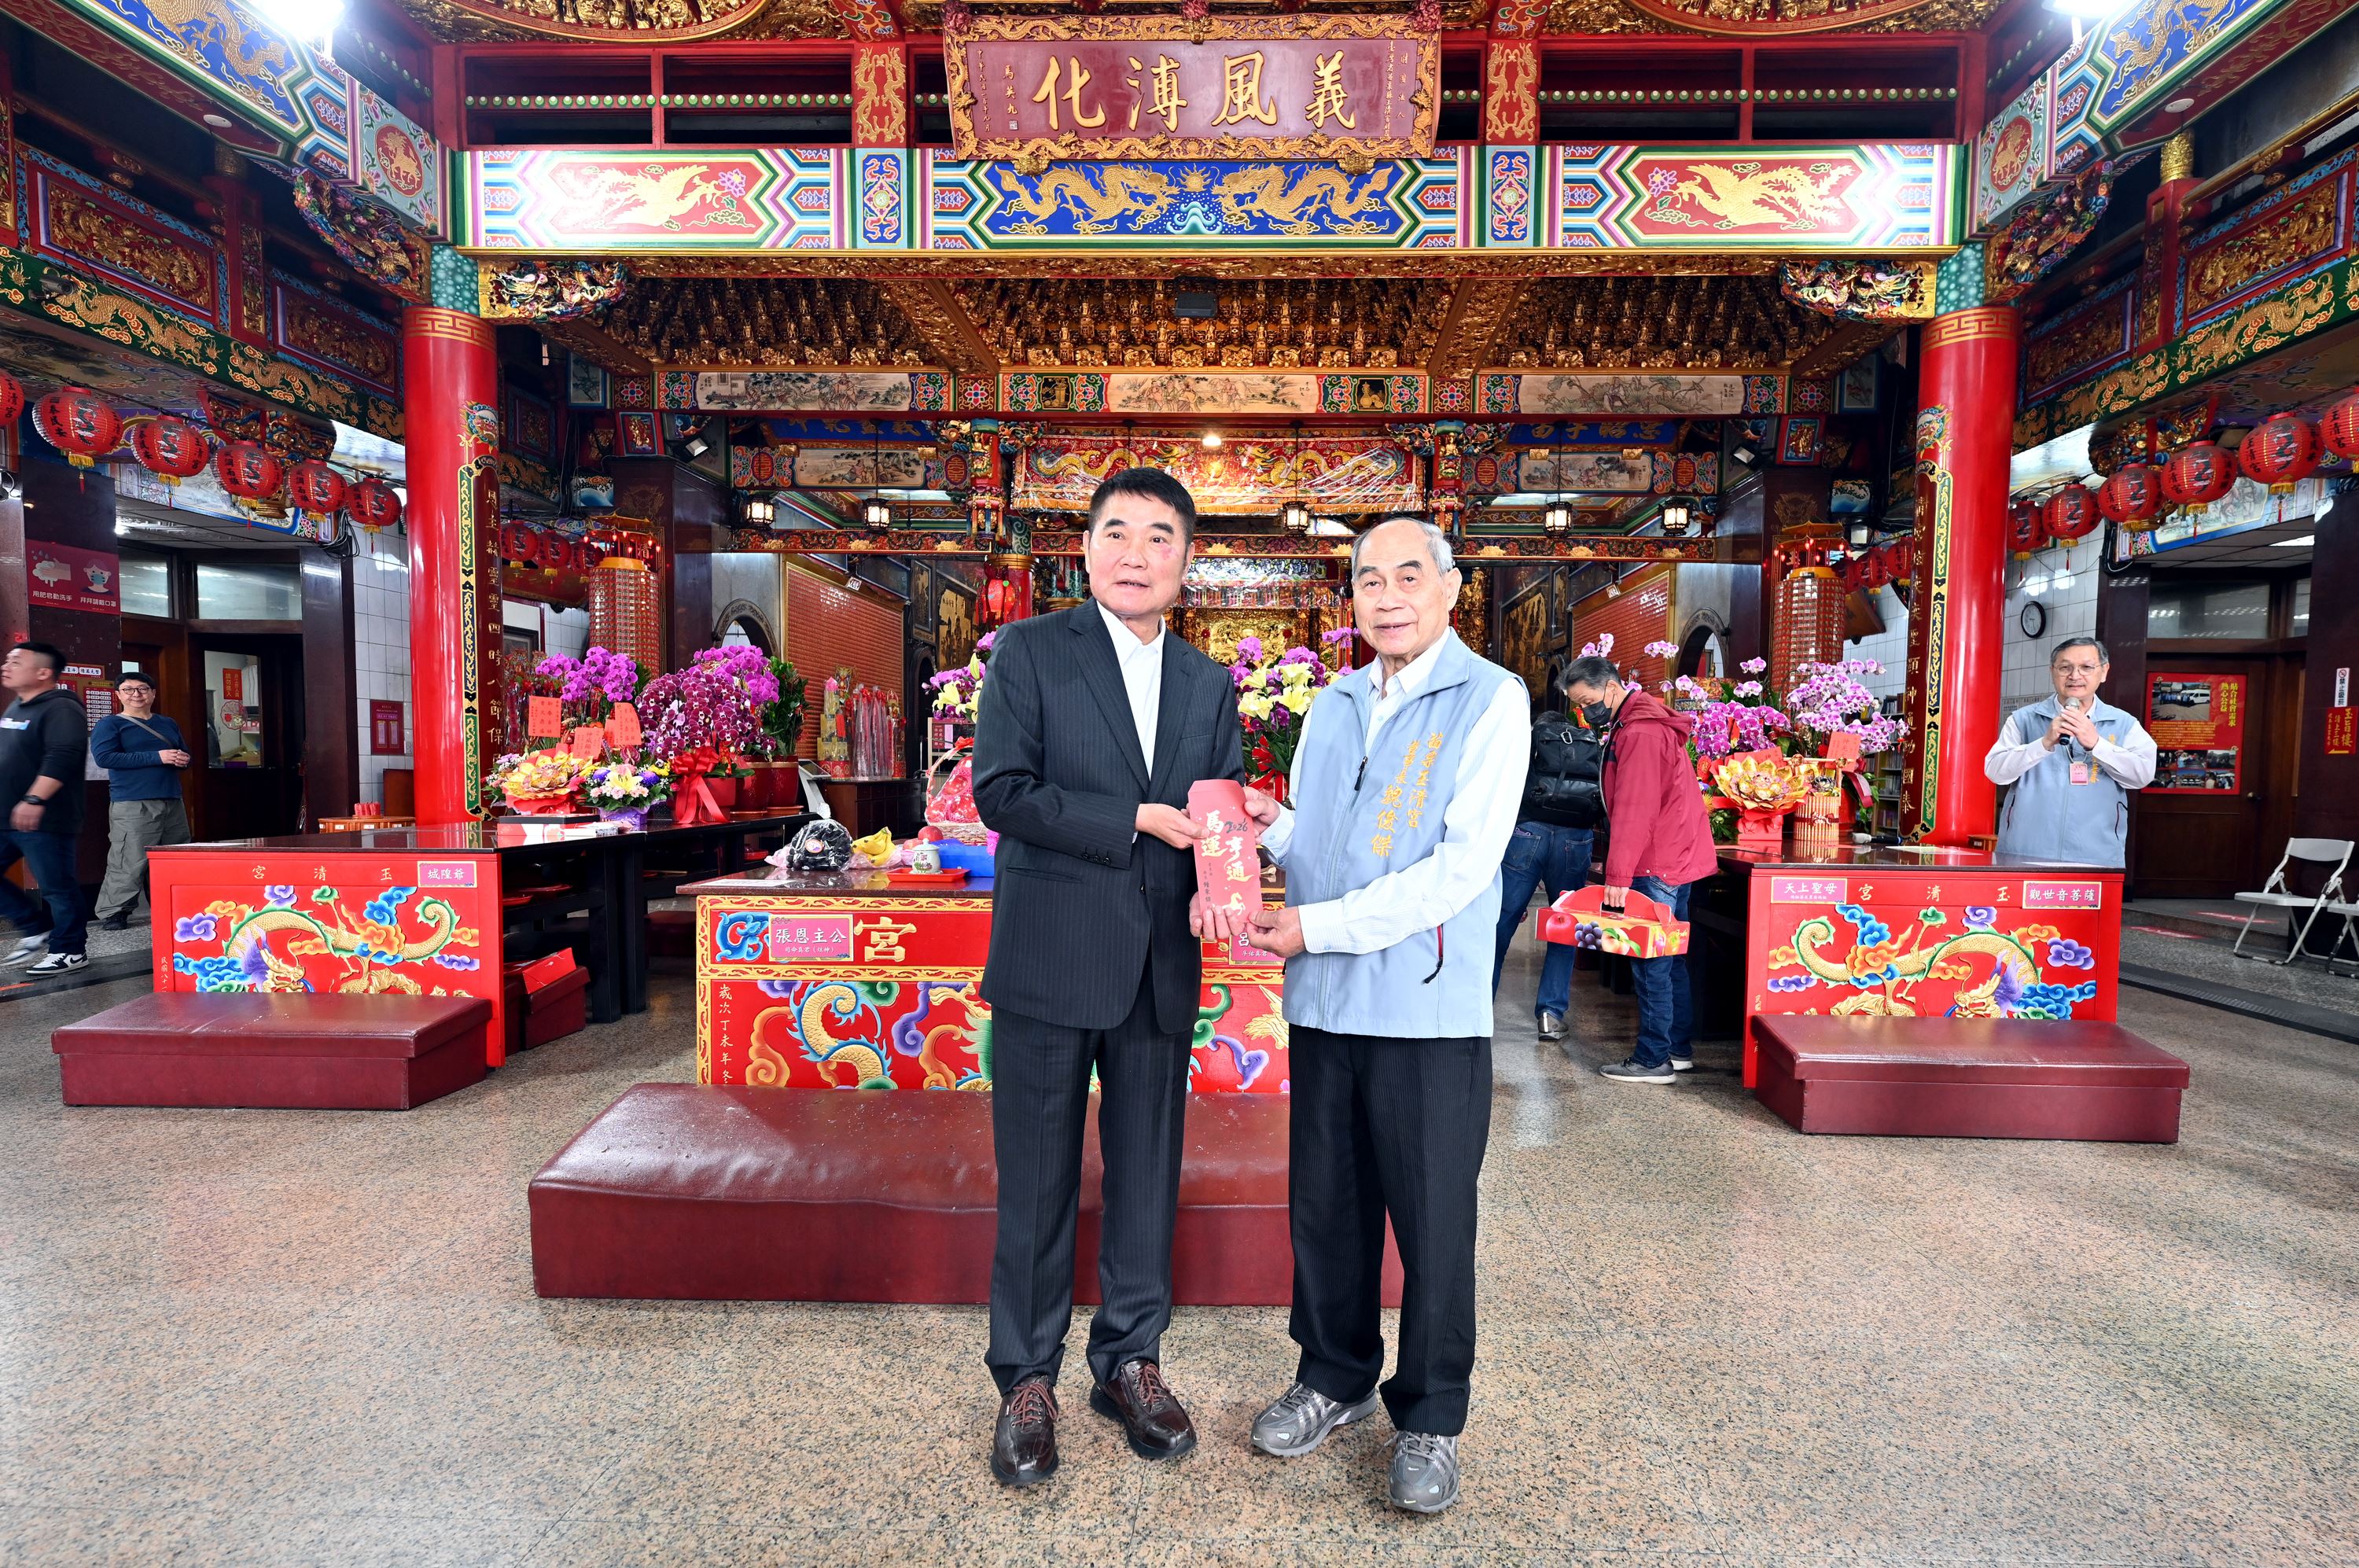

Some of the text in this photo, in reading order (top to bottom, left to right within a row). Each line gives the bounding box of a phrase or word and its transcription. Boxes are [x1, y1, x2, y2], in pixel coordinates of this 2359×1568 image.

[1003, 64, 1018, 115] 馬英九
[1224, 818, 1249, 834] 2026
[427, 867, 465, 881] 城隍爺
[1783, 882, 1838, 894] 天上聖母
[2029, 889, 2096, 902] 觀世音菩薩
[775, 928, 847, 944] 張恩主公
[853, 916, 917, 963] 宮
